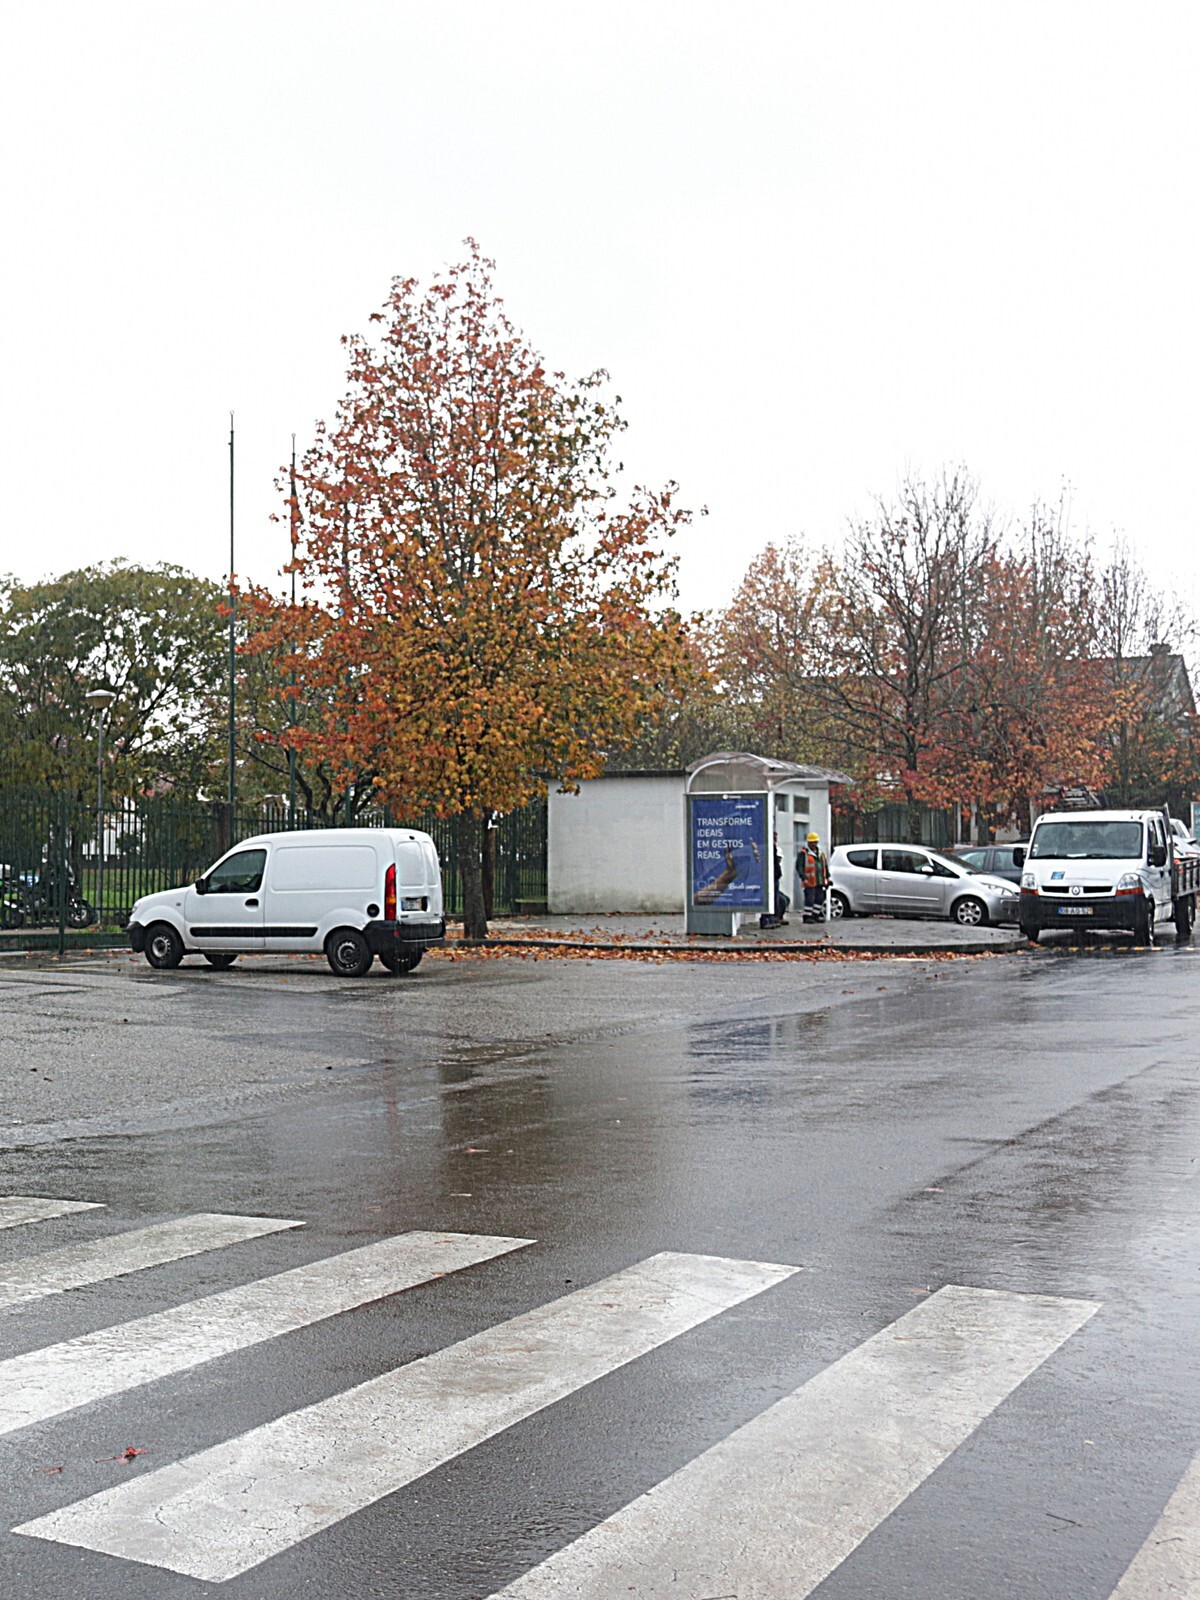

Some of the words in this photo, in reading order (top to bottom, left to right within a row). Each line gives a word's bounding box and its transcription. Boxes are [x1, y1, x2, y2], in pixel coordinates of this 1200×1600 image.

[696, 817, 753, 827] TRANSFORME
[696, 829, 724, 838] IDEAIS
[696, 840, 710, 849] EM
[711, 840, 744, 849] GESTOS
[697, 851, 721, 860] REAIS
